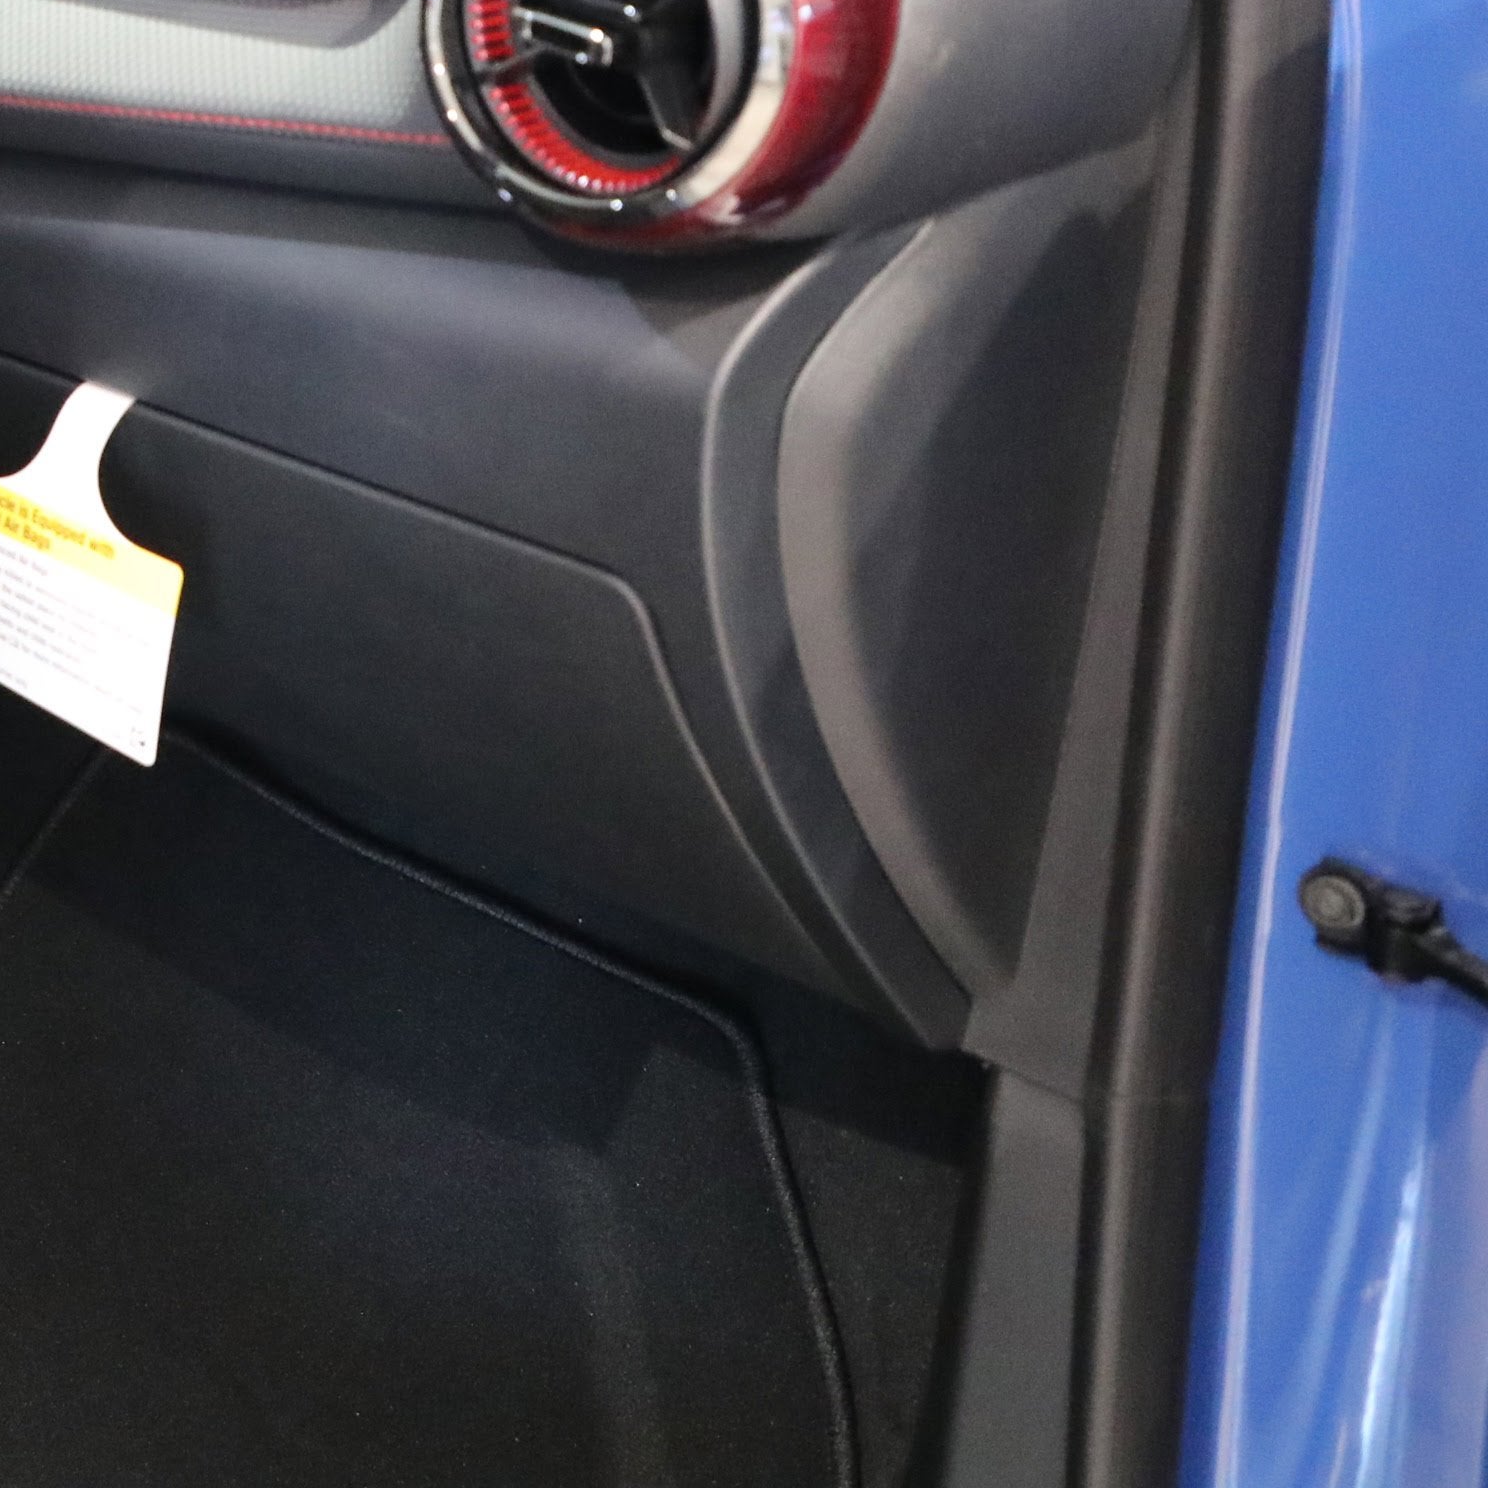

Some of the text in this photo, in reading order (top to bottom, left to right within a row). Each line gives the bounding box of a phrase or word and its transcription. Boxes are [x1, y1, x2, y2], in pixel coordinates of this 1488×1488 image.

[4, 516, 19, 534] Air
[23, 524, 50, 552] Bags
[19, 503, 28, 519] is
[32, 508, 85, 547] Equipped
[89, 536, 114, 560] with
